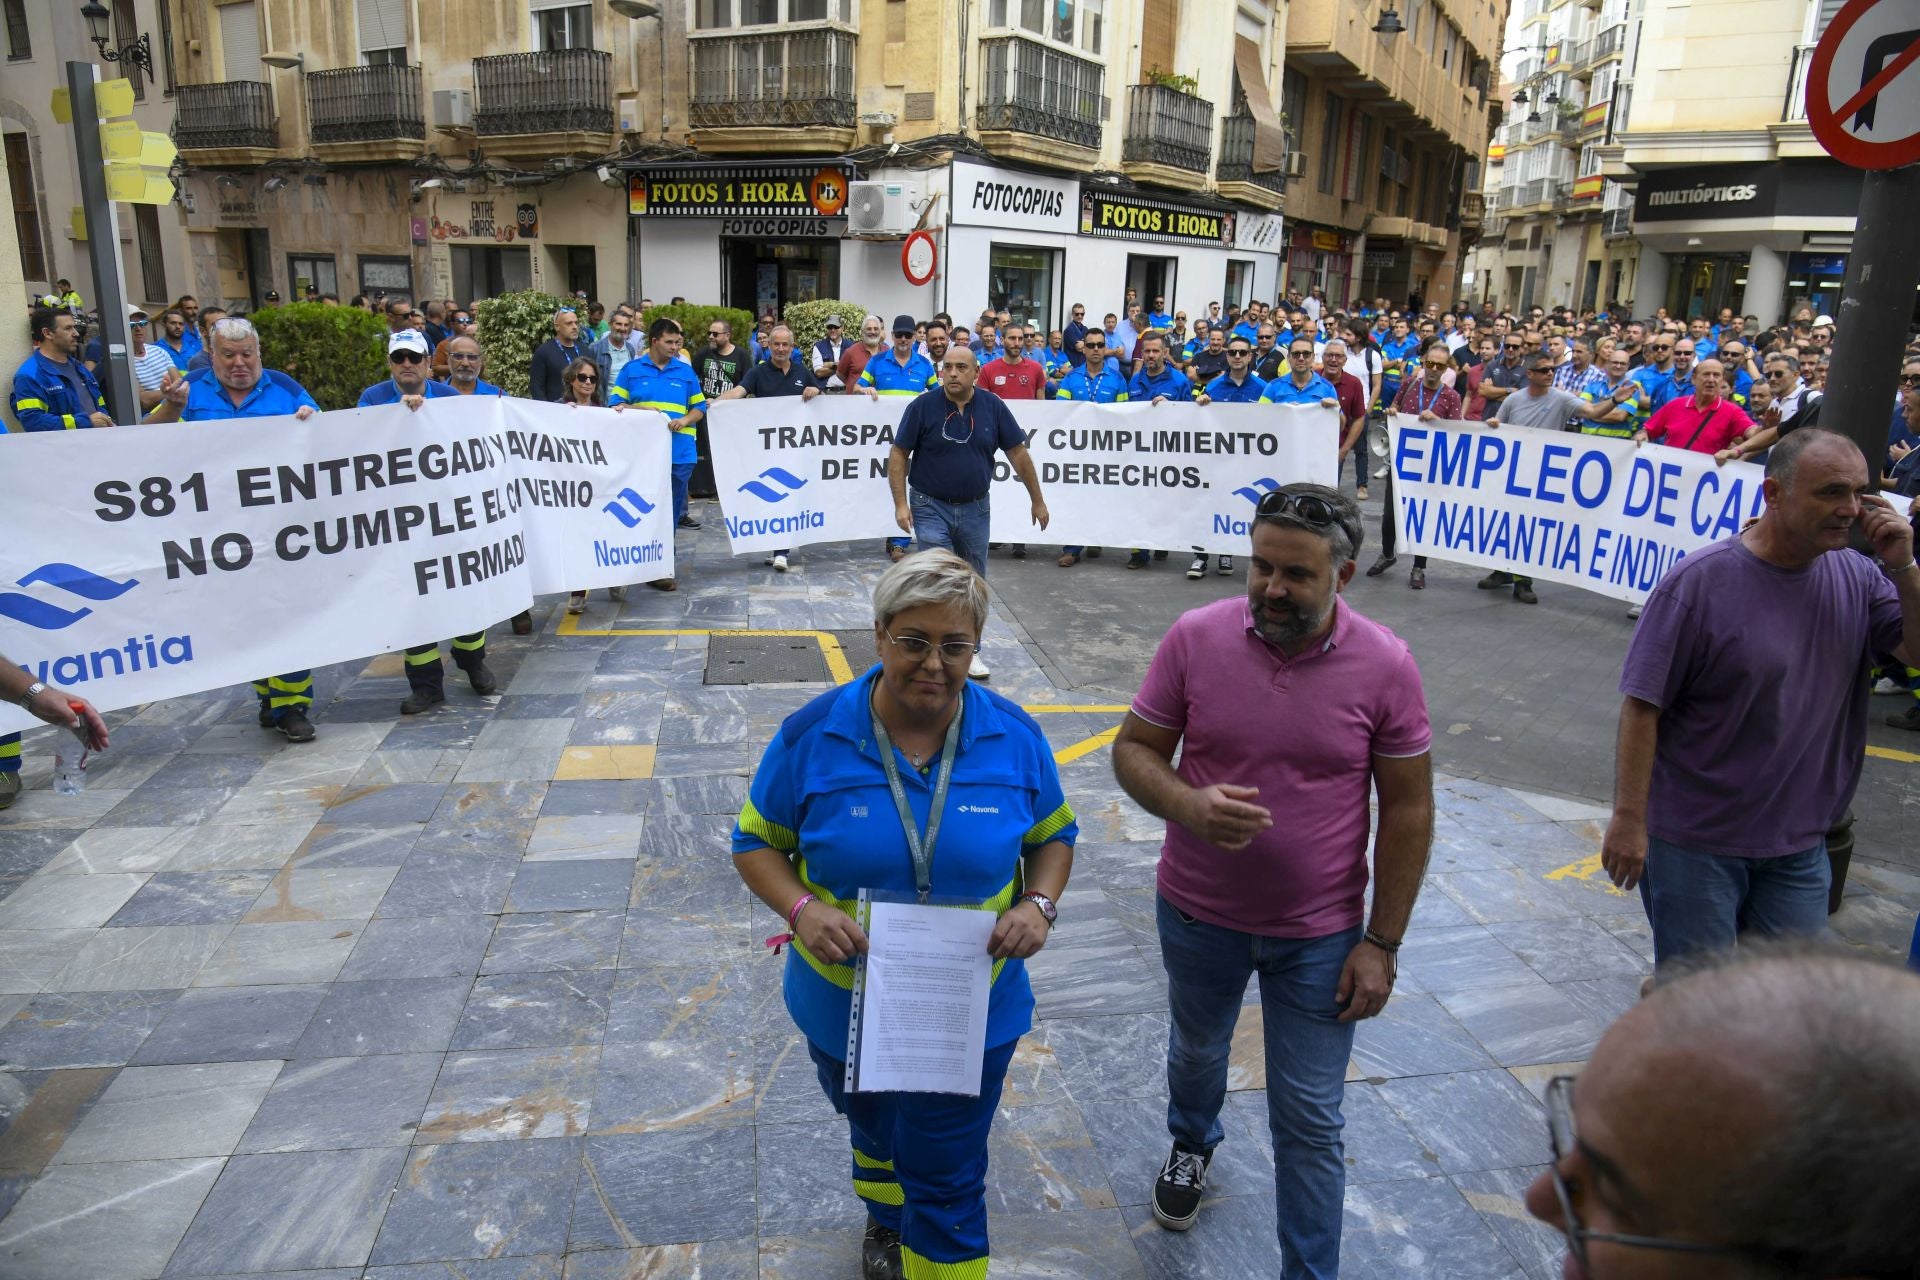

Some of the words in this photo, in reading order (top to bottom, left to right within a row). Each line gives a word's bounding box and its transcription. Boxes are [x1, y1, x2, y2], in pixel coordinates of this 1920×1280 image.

[652, 183, 719, 203] FOTOS
[725, 183, 735, 203] 1
[741, 182, 807, 203] HORA
[816, 182, 841, 200] Pix
[973, 180, 1064, 217] FOTOCOPIAS
[471, 201, 495, 219] ENTRE
[1101, 203, 1162, 232] FOTOS
[1168, 213, 1175, 234] 1
[1177, 215, 1219, 238] HORA
[469, 220, 496, 237] HORAS
[722, 219, 828, 236] FOTOCOPIAS
[1048, 428, 1279, 456] CUMPLIMIENTO
[93, 471, 209, 523] S81
[236, 434, 495, 508] ENTREGADO
[488, 433, 507, 463] Y
[506, 430, 608, 466] AVANTIA
[821, 458, 860, 481] DE
[1042, 462, 1210, 489] DERECHOS.
[1395, 427, 1613, 509] EMPLEO
[1622, 457, 1683, 528] DE
[1691, 471, 1764, 541] CA
[161, 531, 254, 580] NO
[274, 495, 477, 562] CUMPLE
[482, 489, 506, 524] EL
[725, 509, 825, 540] Navantia
[1402, 496, 1428, 544] N
[1433, 500, 1581, 574] NAVANTIA
[1588, 528, 1612, 579] E
[414, 530, 528, 596] FIRMAD
[594, 539, 663, 568] Navantia
[970, 804, 999, 814] Navantia
